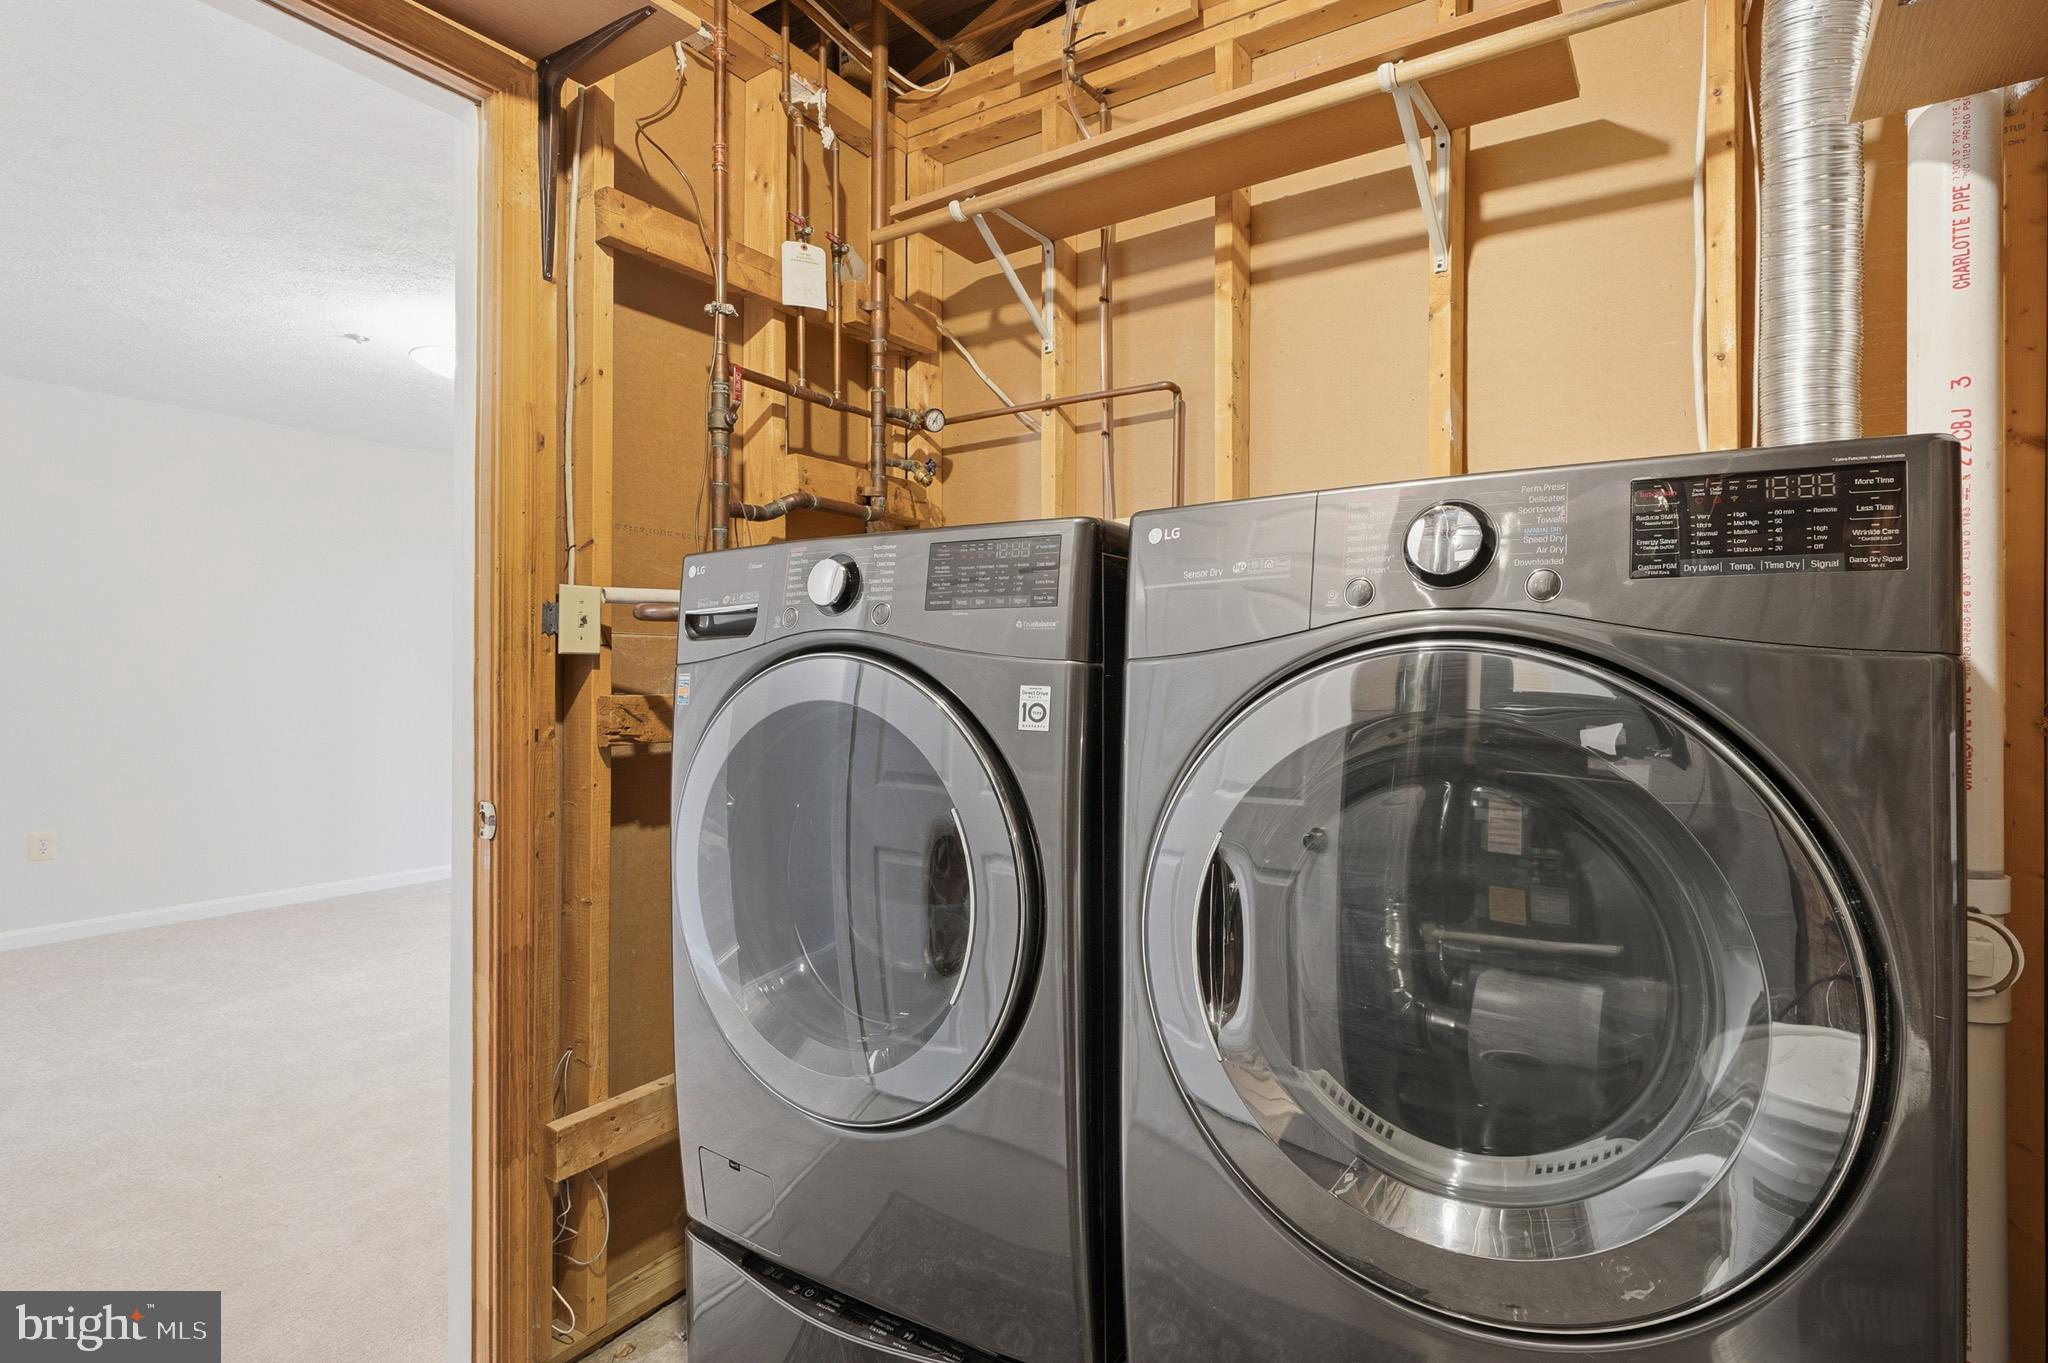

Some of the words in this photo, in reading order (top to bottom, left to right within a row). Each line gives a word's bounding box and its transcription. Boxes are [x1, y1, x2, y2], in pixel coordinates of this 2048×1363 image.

[1952, 183, 1971, 212] PIPE
[1952, 216, 1971, 290] CHARLOTTE
[1543, 483, 1566, 491] Press
[1528, 495, 1565, 503] Delicates
[1164, 527, 1181, 540] LG
[1852, 528, 1880, 536] Wrinkle
[1523, 535, 1548, 544] Speed
[1550, 534, 1565, 543] Dry
[1536, 546, 1548, 554] Air
[1550, 545, 1564, 554] Dry
[1514, 557, 1564, 567] Downloaded
[1811, 559, 1839, 569] Signal
[1869, 555, 1881, 563] Dry
[1882, 555, 1904, 563] Signal
[1684, 564, 1698, 573] Dry
[1699, 563, 1720, 572] Level
[1729, 562, 1756, 571] Temp.
[1765, 561, 1784, 569] Time
[1786, 560, 1801, 571] Dry
[1183, 569, 1209, 580] Sensor
[1210, 567, 1224, 578] Dry
[1022, 702, 1047, 723] 10
